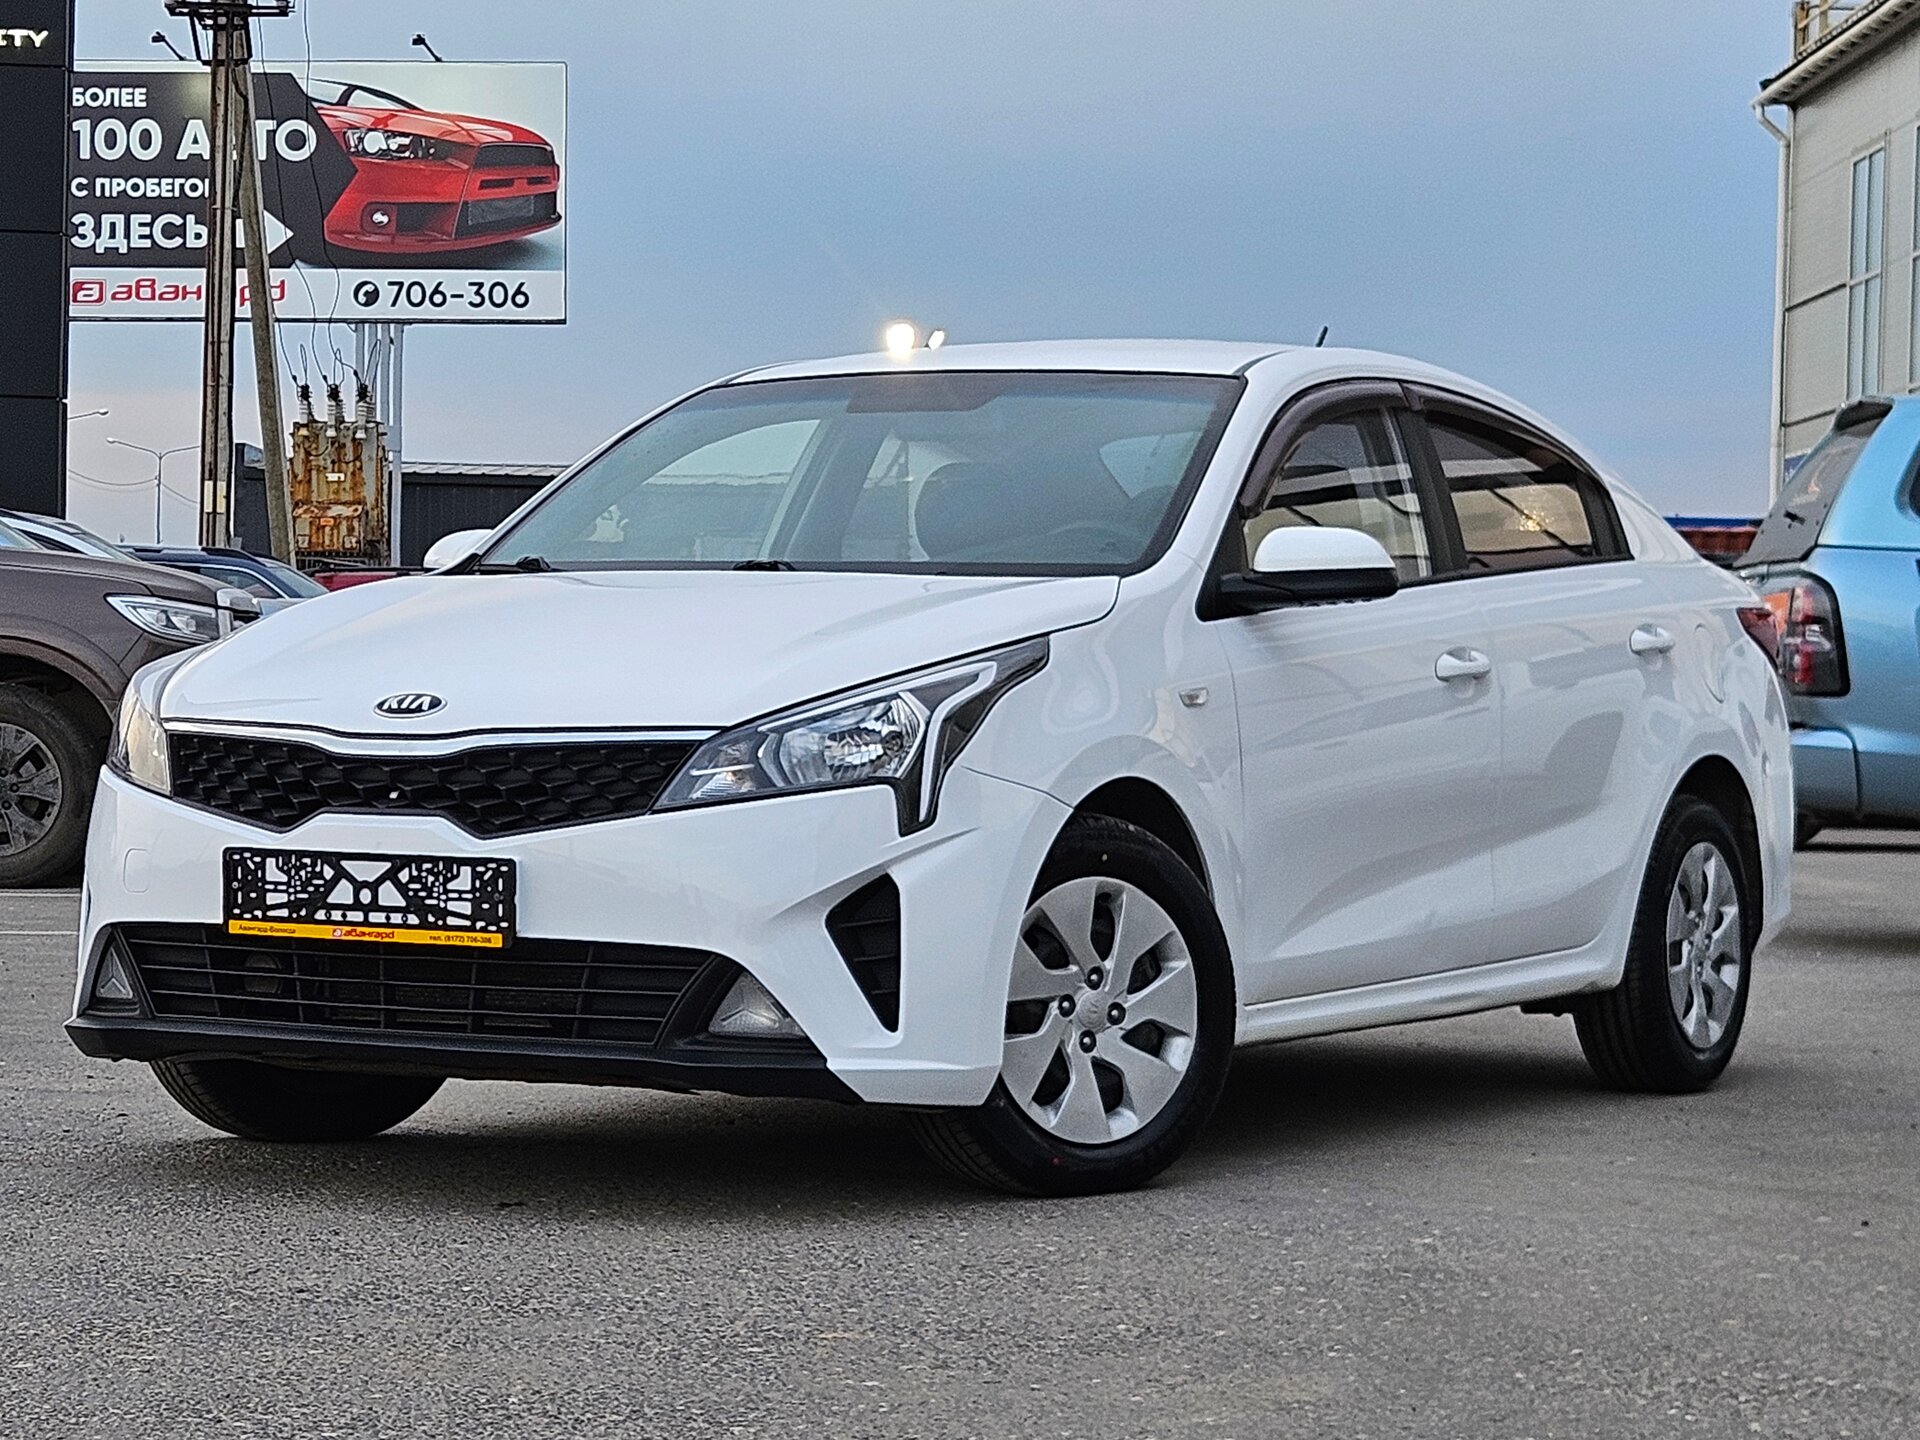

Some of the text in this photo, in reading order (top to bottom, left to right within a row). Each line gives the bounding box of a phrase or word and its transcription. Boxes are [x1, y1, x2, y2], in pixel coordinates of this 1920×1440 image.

[71, 87, 147, 107] БОЛЕЕ
[71, 118, 317, 161] 100 АТО
[70, 177, 210, 198] С ПРОБЕГО
[70, 213, 209, 254] ЗДЕСЬ
[387, 280, 530, 308] 706-306
[381, 694, 433, 711] KIA
